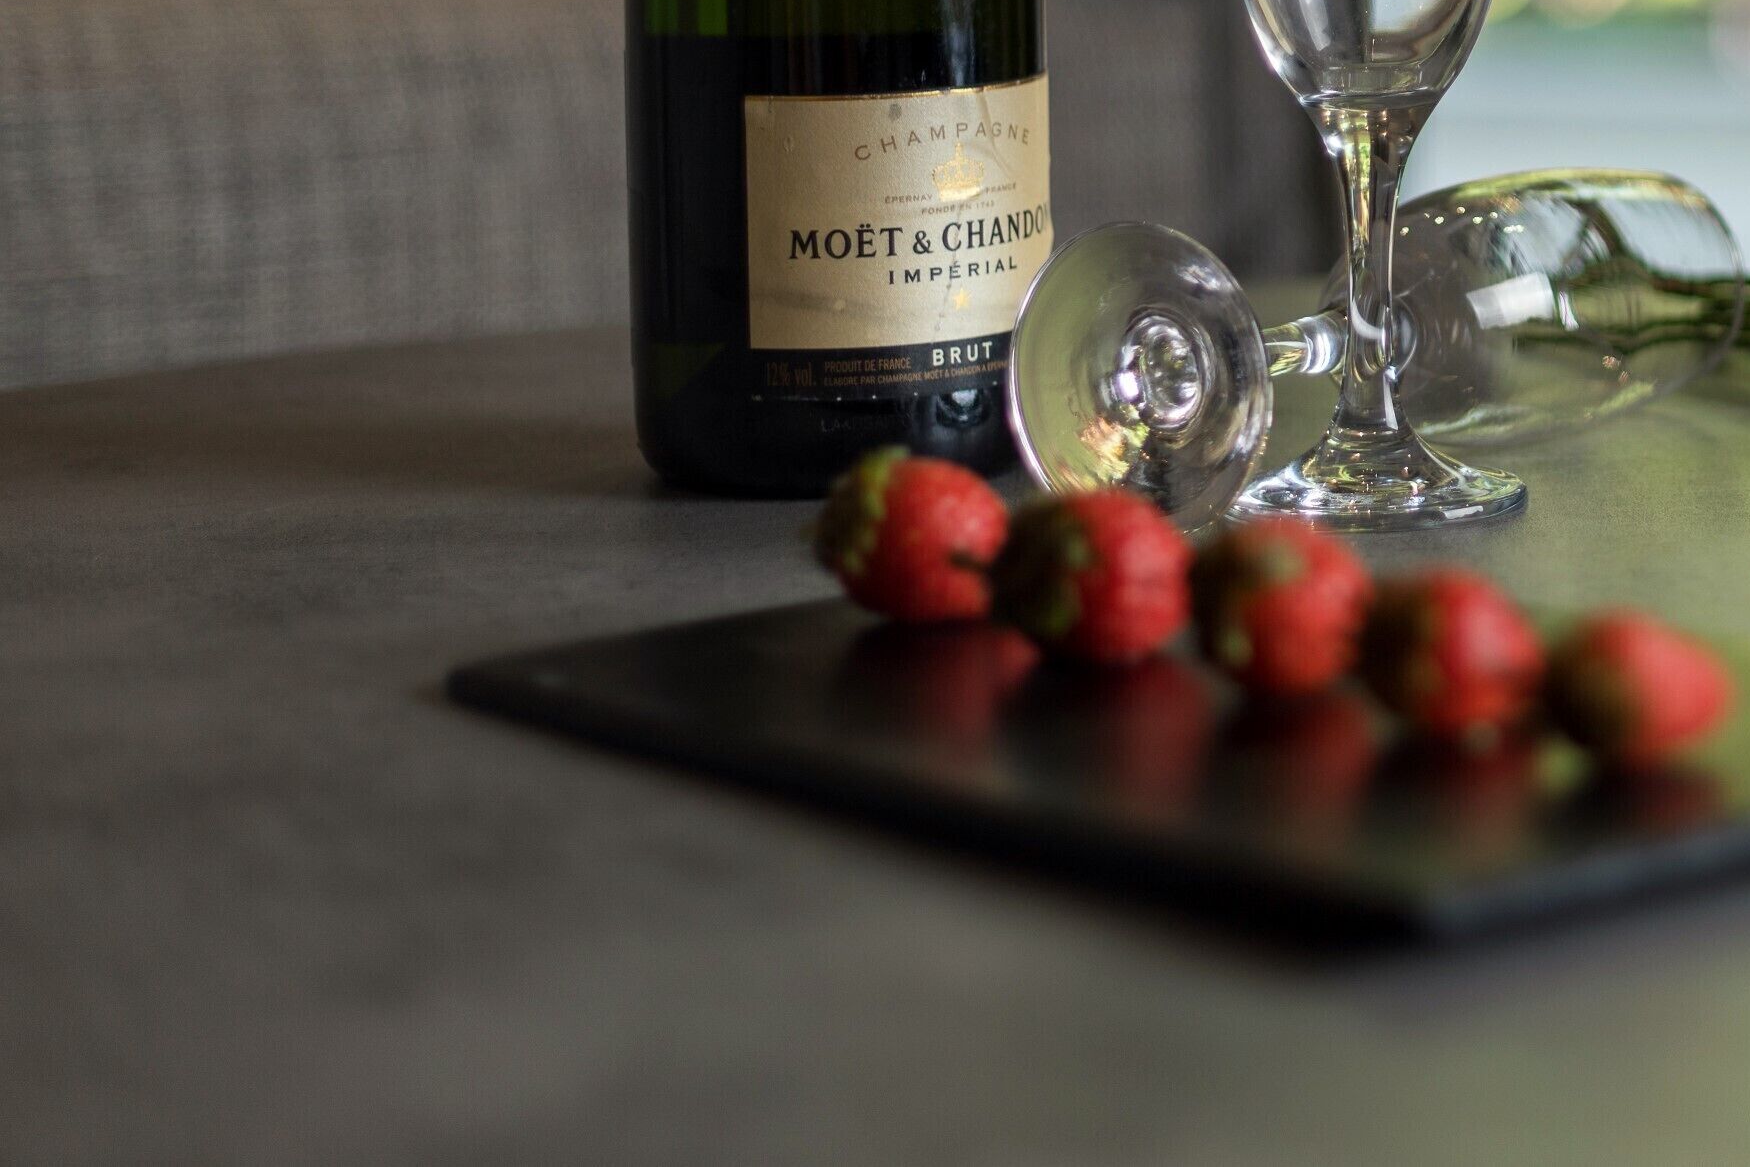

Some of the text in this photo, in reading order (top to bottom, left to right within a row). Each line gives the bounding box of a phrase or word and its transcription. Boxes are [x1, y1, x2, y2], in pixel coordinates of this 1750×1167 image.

[855, 122, 1030, 161] CHAMPAGNE
[984, 182, 1017, 194] FRANCE
[789, 223, 904, 260] MOËT
[912, 230, 934, 255] &
[889, 256, 1018, 285] IMPÉRIAL
[823, 356, 912, 372] PRODUIT DE FRANCE
[931, 341, 993, 367] BRUT
[860, 374, 876, 385] PAR
[877, 371, 922, 384] CHAMPAGNE
